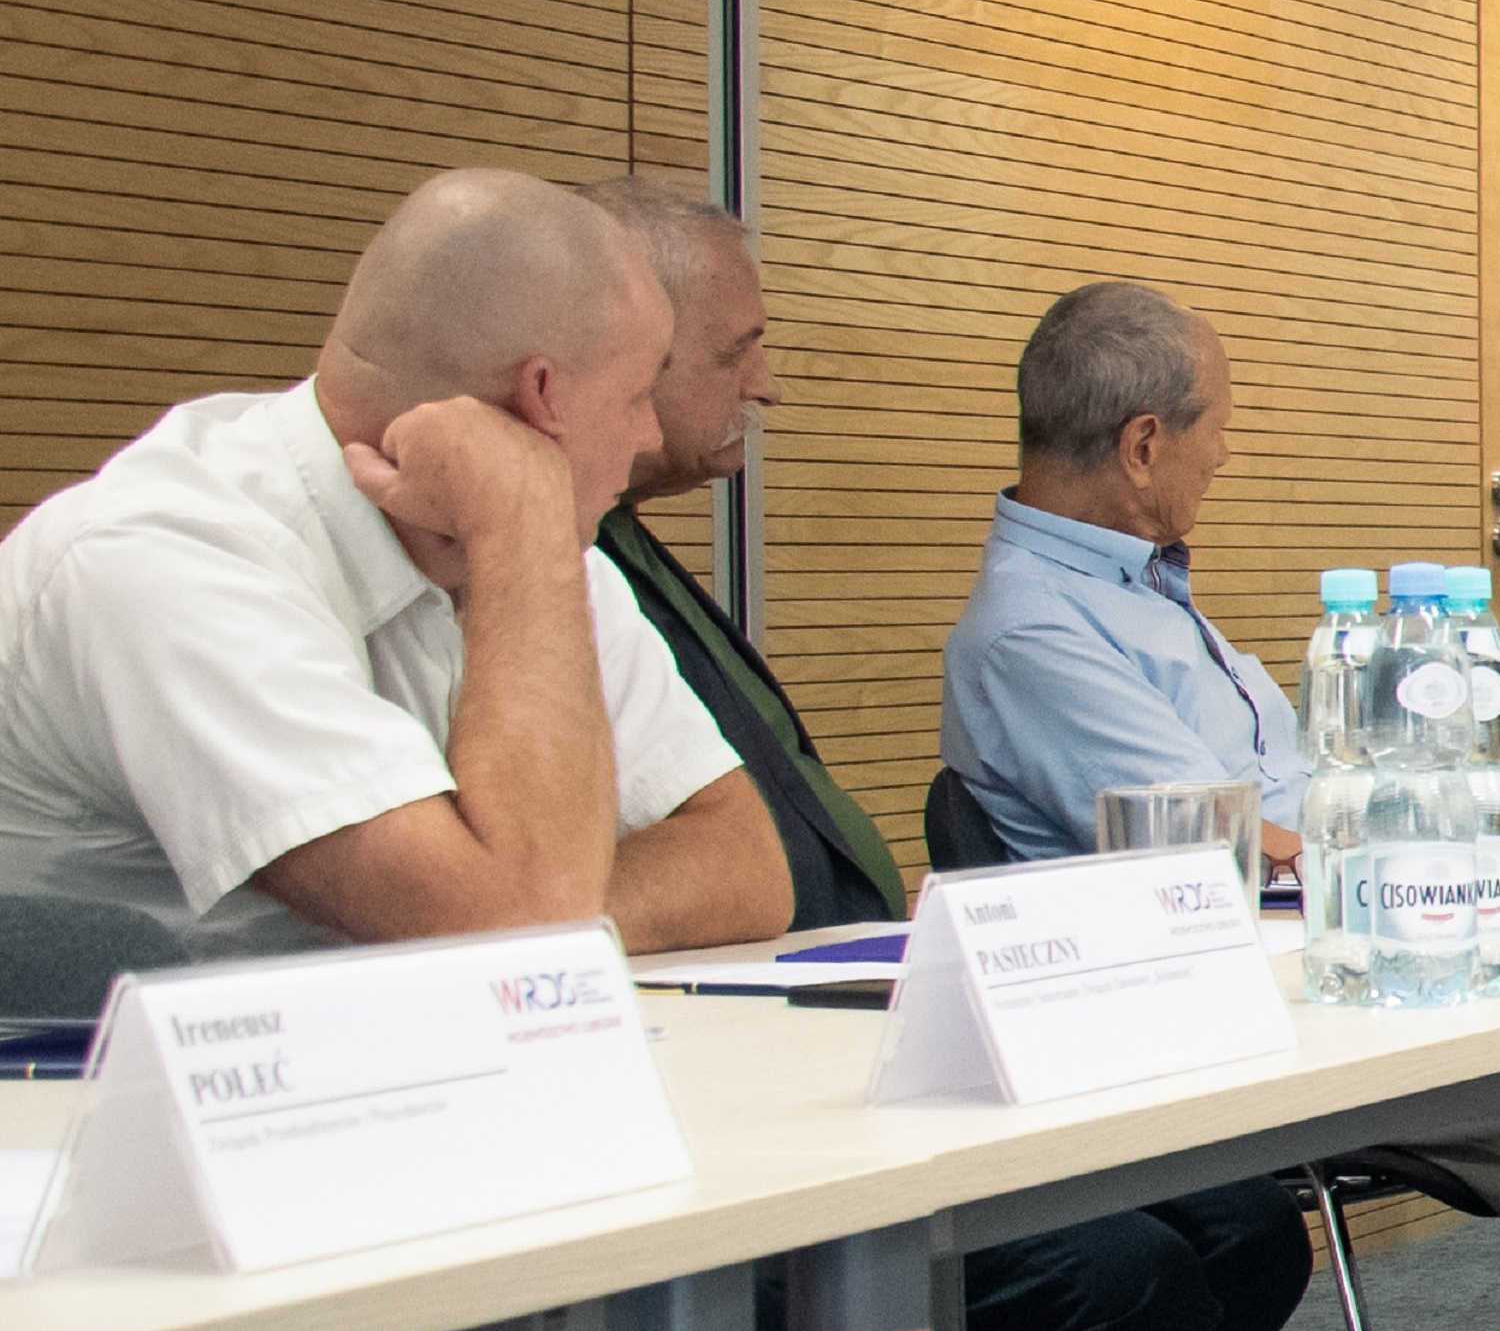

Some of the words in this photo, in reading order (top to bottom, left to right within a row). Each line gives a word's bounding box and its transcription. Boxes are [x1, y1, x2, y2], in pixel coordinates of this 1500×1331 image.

[963, 896, 1018, 927] Antoni
[1380, 881, 1478, 910] CISOWIANK
[975, 937, 1083, 976] PASIECZNY
[169, 1010, 285, 1049] Ireneusz
[187, 1049, 296, 1106] POLEĆ
